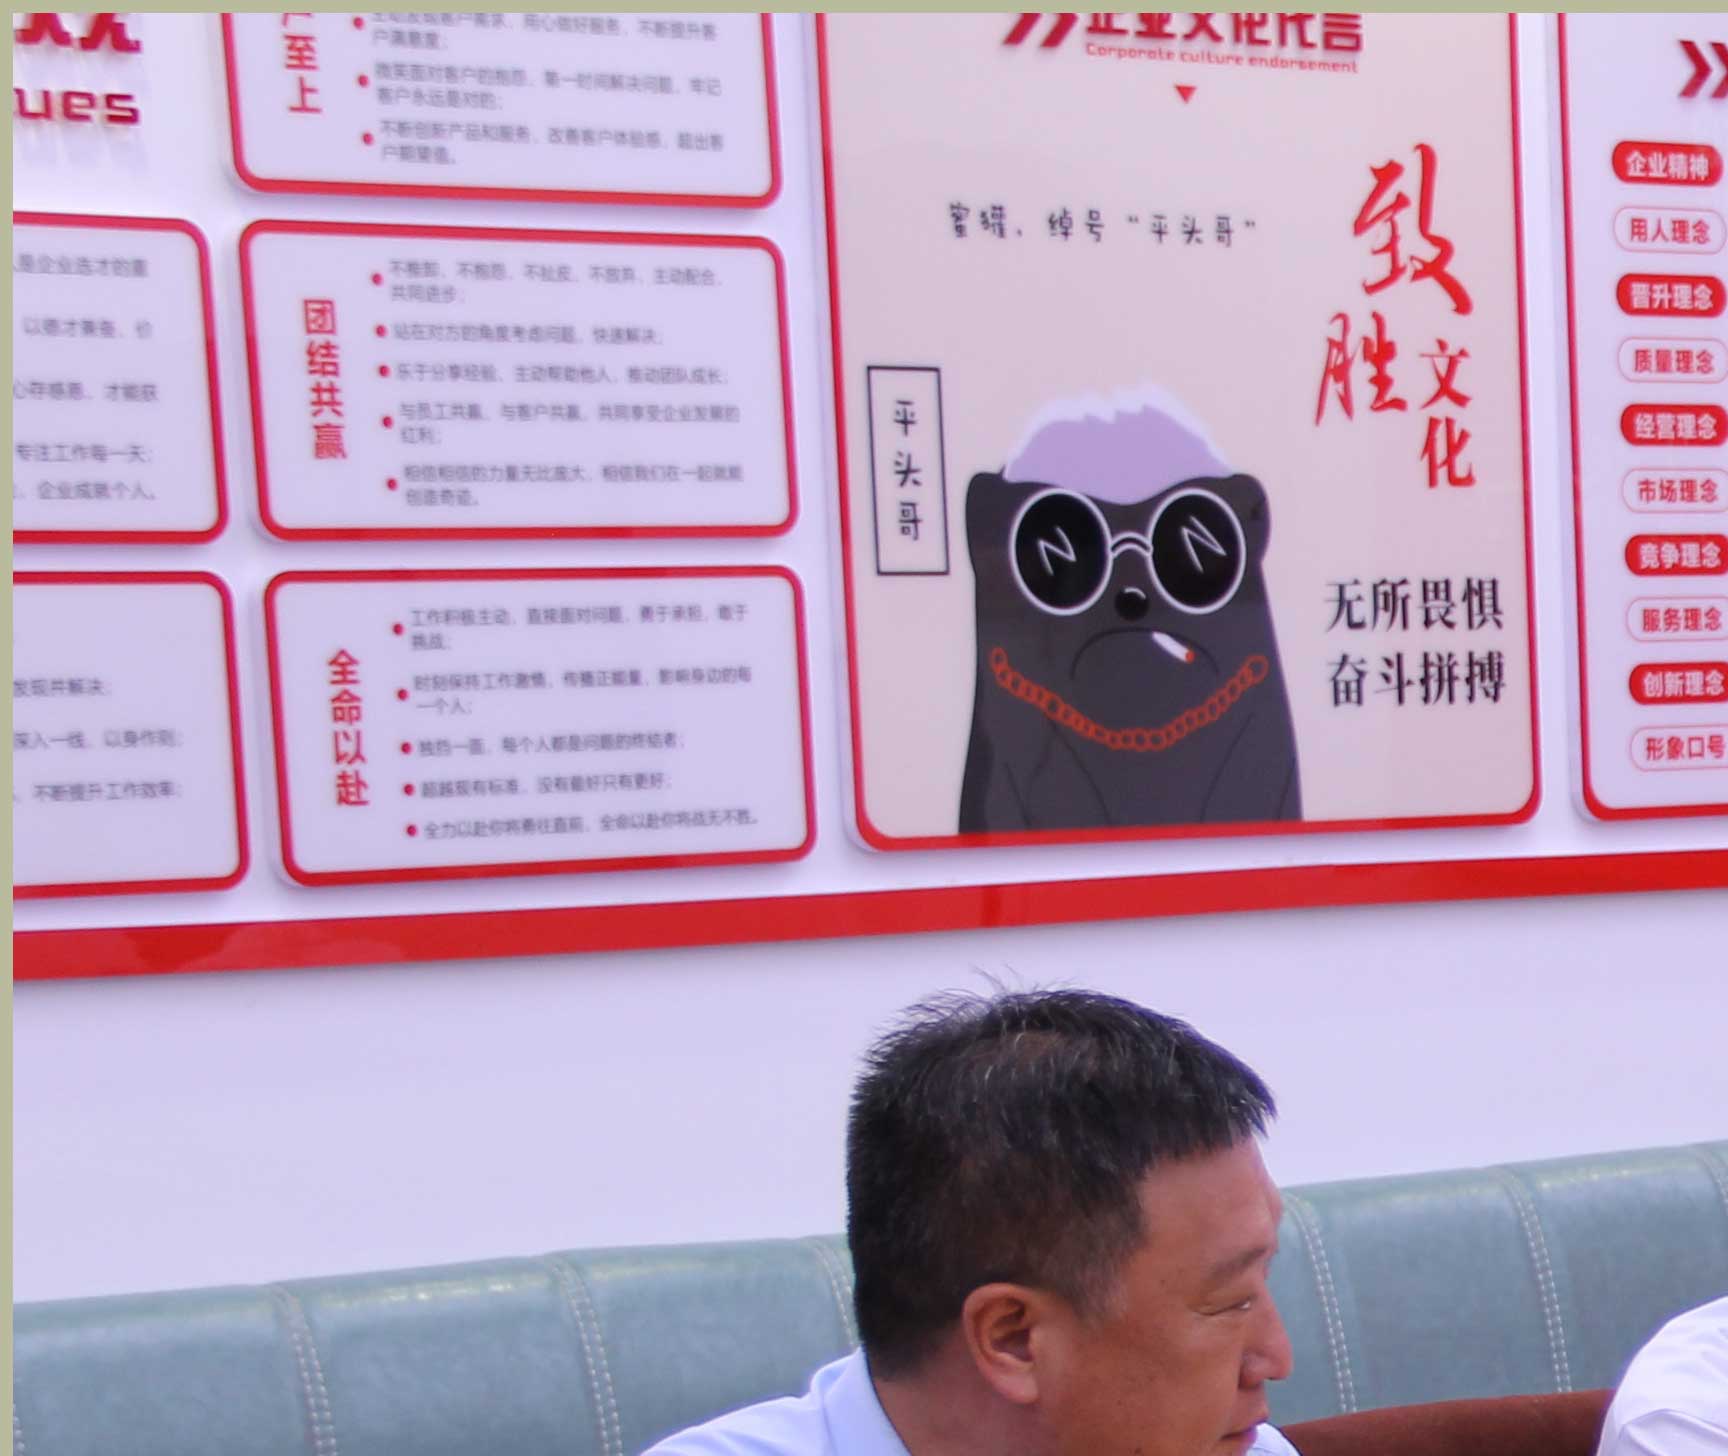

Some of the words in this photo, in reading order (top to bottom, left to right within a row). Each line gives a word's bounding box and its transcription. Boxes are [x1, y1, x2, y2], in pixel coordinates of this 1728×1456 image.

[1086, 43, 1175, 62] Corporate
[1181, 49, 1244, 66] culture
[1249, 56, 1360, 74] endorsement
[1626, 152, 1709, 181] 企业精神
[1630, 218, 1711, 245] 用人理念
[1630, 283, 1714, 311] 晋升理念
[1633, 349, 1715, 374] 质量理念
[302, 298, 347, 460] 团结共赢
[1418, 339, 1477, 489] 文化
[1634, 413, 1717, 439] 经营理念
[892, 398, 924, 542] 平头哥
[1637, 478, 1719, 503] 市场理念
[1639, 543, 1722, 569] 竞争理念
[1324, 577, 1505, 633] 无所畏惧
[1642, 607, 1723, 632] 服务理念
[1327, 650, 1507, 708] 奋斗拼搏
[1643, 671, 1725, 698] 创新理念
[327, 650, 369, 808] 全命以赴
[1645, 737, 1726, 762] 形象口号
